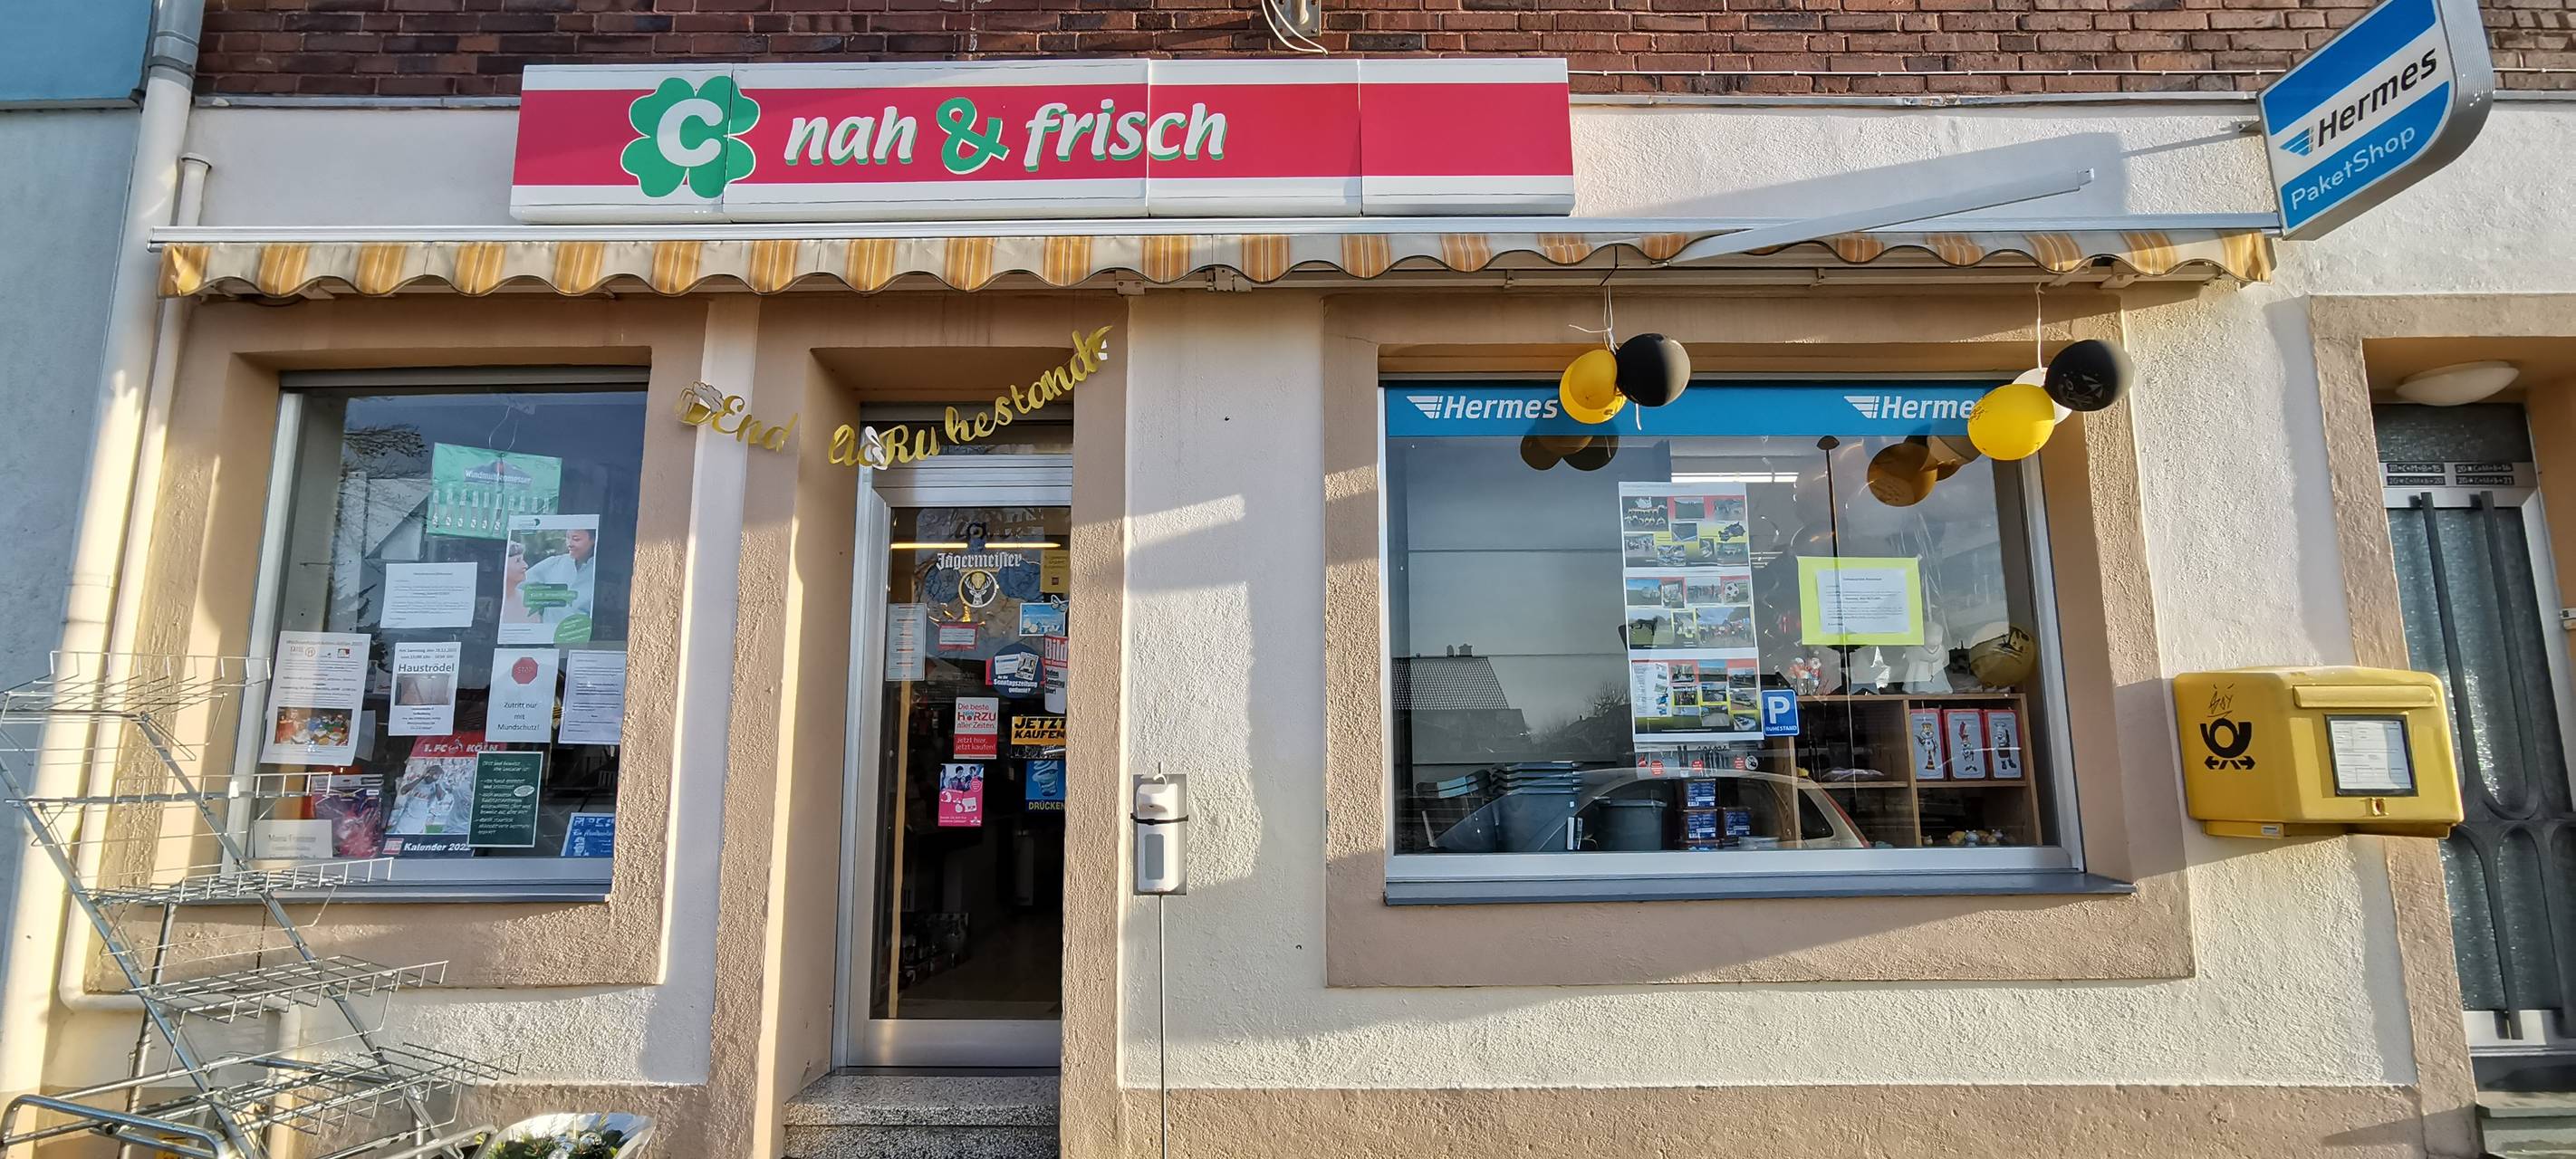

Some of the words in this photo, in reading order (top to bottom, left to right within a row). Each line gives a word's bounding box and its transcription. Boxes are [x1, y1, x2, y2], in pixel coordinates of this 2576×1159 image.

[2318, 48, 2437, 148] Hermes
[783, 105, 917, 165] nah
[936, 96, 1009, 175] &
[1023, 98, 1227, 172] frisch
[2291, 127, 2416, 210] PaketShop
[1443, 396, 1559, 420] Hermes
[1881, 396, 1973, 420] Herme
[937, 551, 1023, 571] Jägermeister
[1044, 637, 1068, 661] Bild
[399, 663, 455, 673] Hauströdel
[1767, 696, 1790, 723] P
[497, 723, 540, 732] Mundschutz!
[404, 842, 447, 851] Kalender
